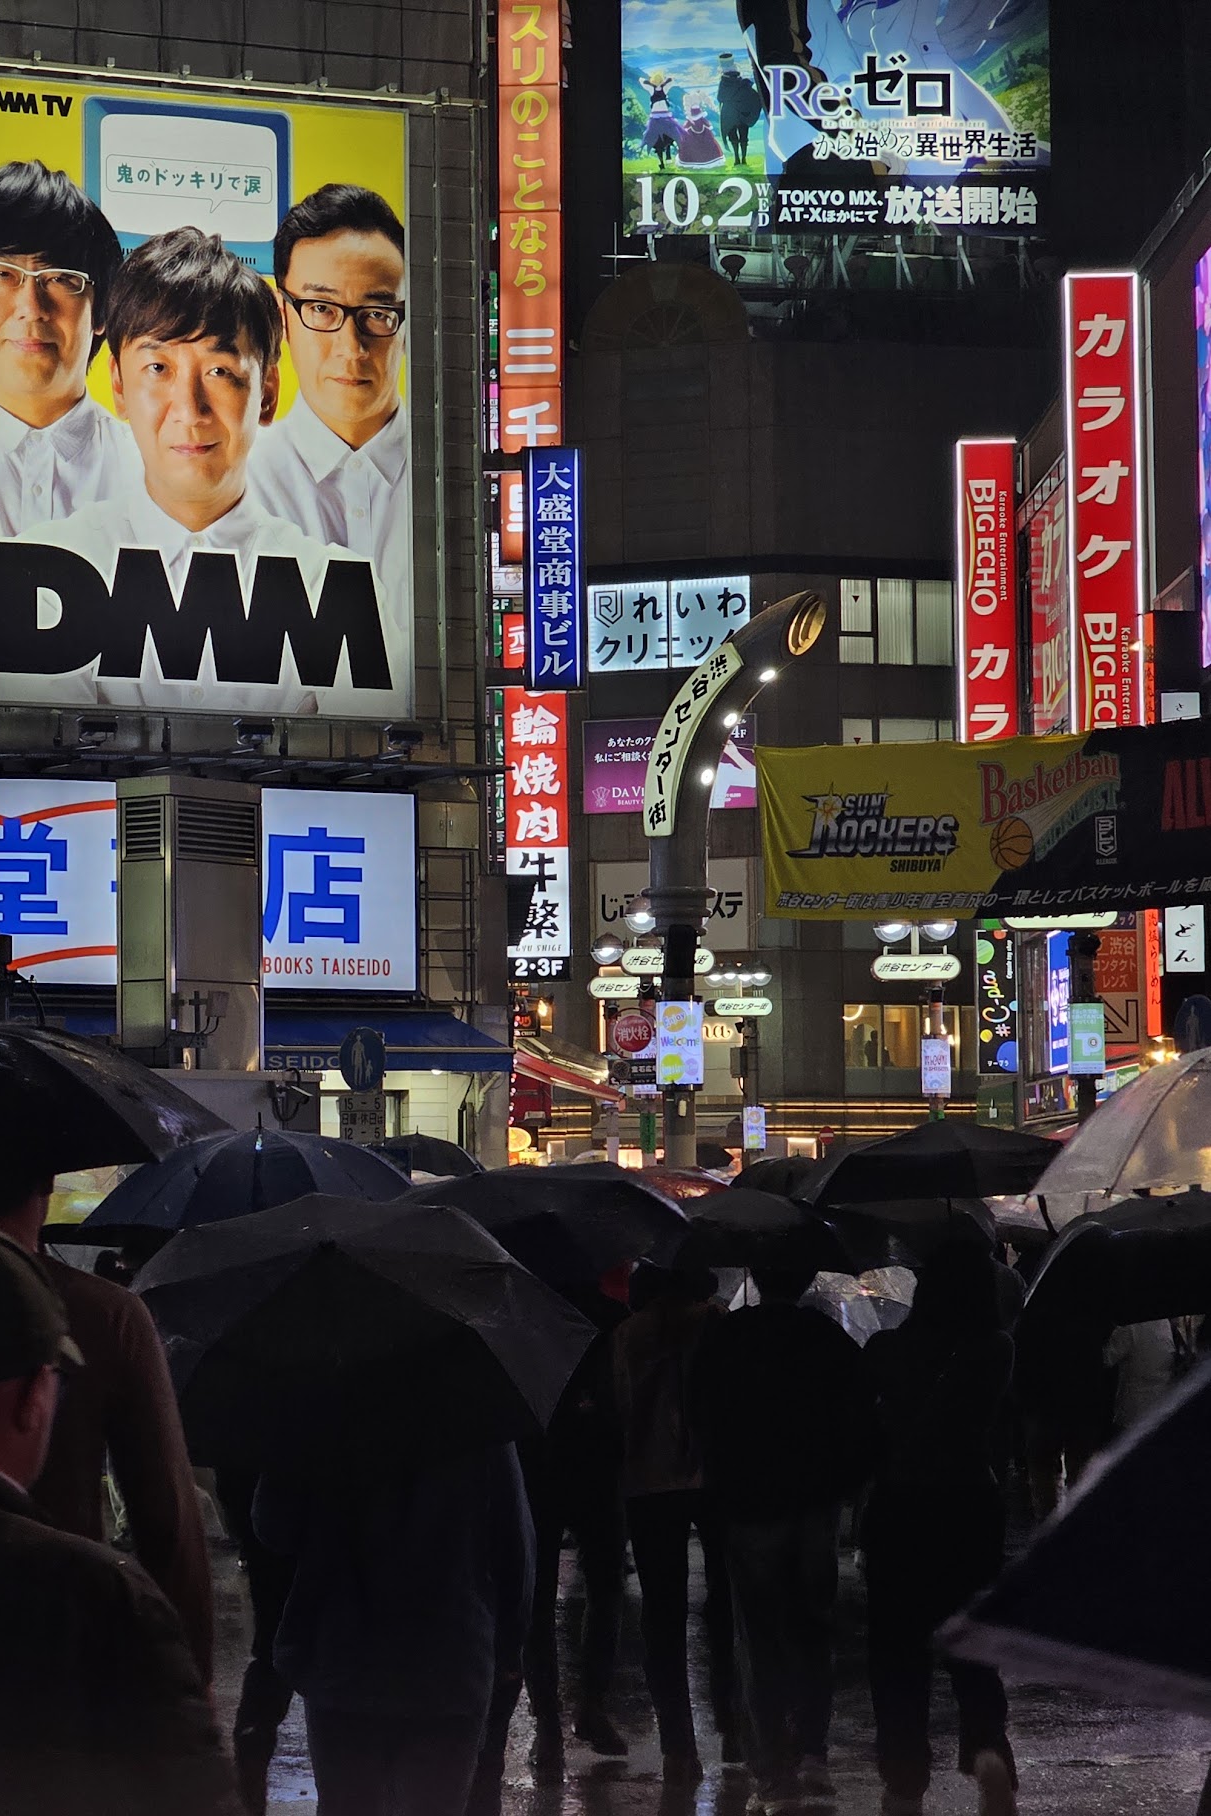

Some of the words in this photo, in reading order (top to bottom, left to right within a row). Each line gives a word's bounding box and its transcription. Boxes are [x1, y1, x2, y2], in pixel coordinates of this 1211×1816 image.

[764, 54, 952, 118] Re:ゼロ
[42, 95, 73, 117] TV
[509, 4, 549, 297] スリのことなら
[815, 129, 1037, 162] から始める異世界生活
[117, 162, 262, 196] 鬼のドッキリで涙
[635, 176, 754, 227] 10.2
[754, 183, 771, 227] WED
[778, 189, 845, 206] TOKYO
[884, 186, 1038, 225] 放送開始
[778, 207, 879, 224] AT-Xほかにて
[1075, 313, 1132, 579] カラオケ
[968, 479, 997, 532] BIG
[998, 490, 1007, 530] Karaoke
[536, 461, 574, 677] 大盛堂商事ビル
[971, 537, 998, 616] ECHO
[999, 531, 1008, 601] Entertainment
[633, 587, 747, 623] れいわ
[1083, 612, 1118, 678] BIG
[1121, 627, 1131, 674] Karaoke
[607, 736, 656, 748] あなたのク
[648, 654, 729, 831] 渋谷センター街
[510, 690, 561, 843] 輪焼肉
[612, 787, 630, 798] DA
[979, 750, 1120, 825] Basketball
[844, 795, 889, 816] SUN
[786, 793, 960, 859] ROCKERS
[890, 859, 940, 873] SHIBUYA
[536, 943, 562, 952] SHIGE
[1109, 936, 1136, 956] 渋谷
[263, 957, 314, 976] BOOKS
[321, 957, 392, 977] TAISEIDO
[626, 954, 709, 966] 渋谷セ街
[877, 961, 955, 973] 渋谷センター街
[1092, 959, 1137, 971] コンタクト
[1103, 975, 1129, 989] レンズ
[717, 1002, 770, 1012] 渋谷センター街
[663, 1011, 686, 1028] Enjoy
[617, 1025, 650, 1042] 消火栓
[660, 1035, 701, 1047] Welcome
[268, 1054, 340, 1069] SEIDO
[344, 1098, 354, 1110] 15
[344, 1127, 354, 1140] 12
